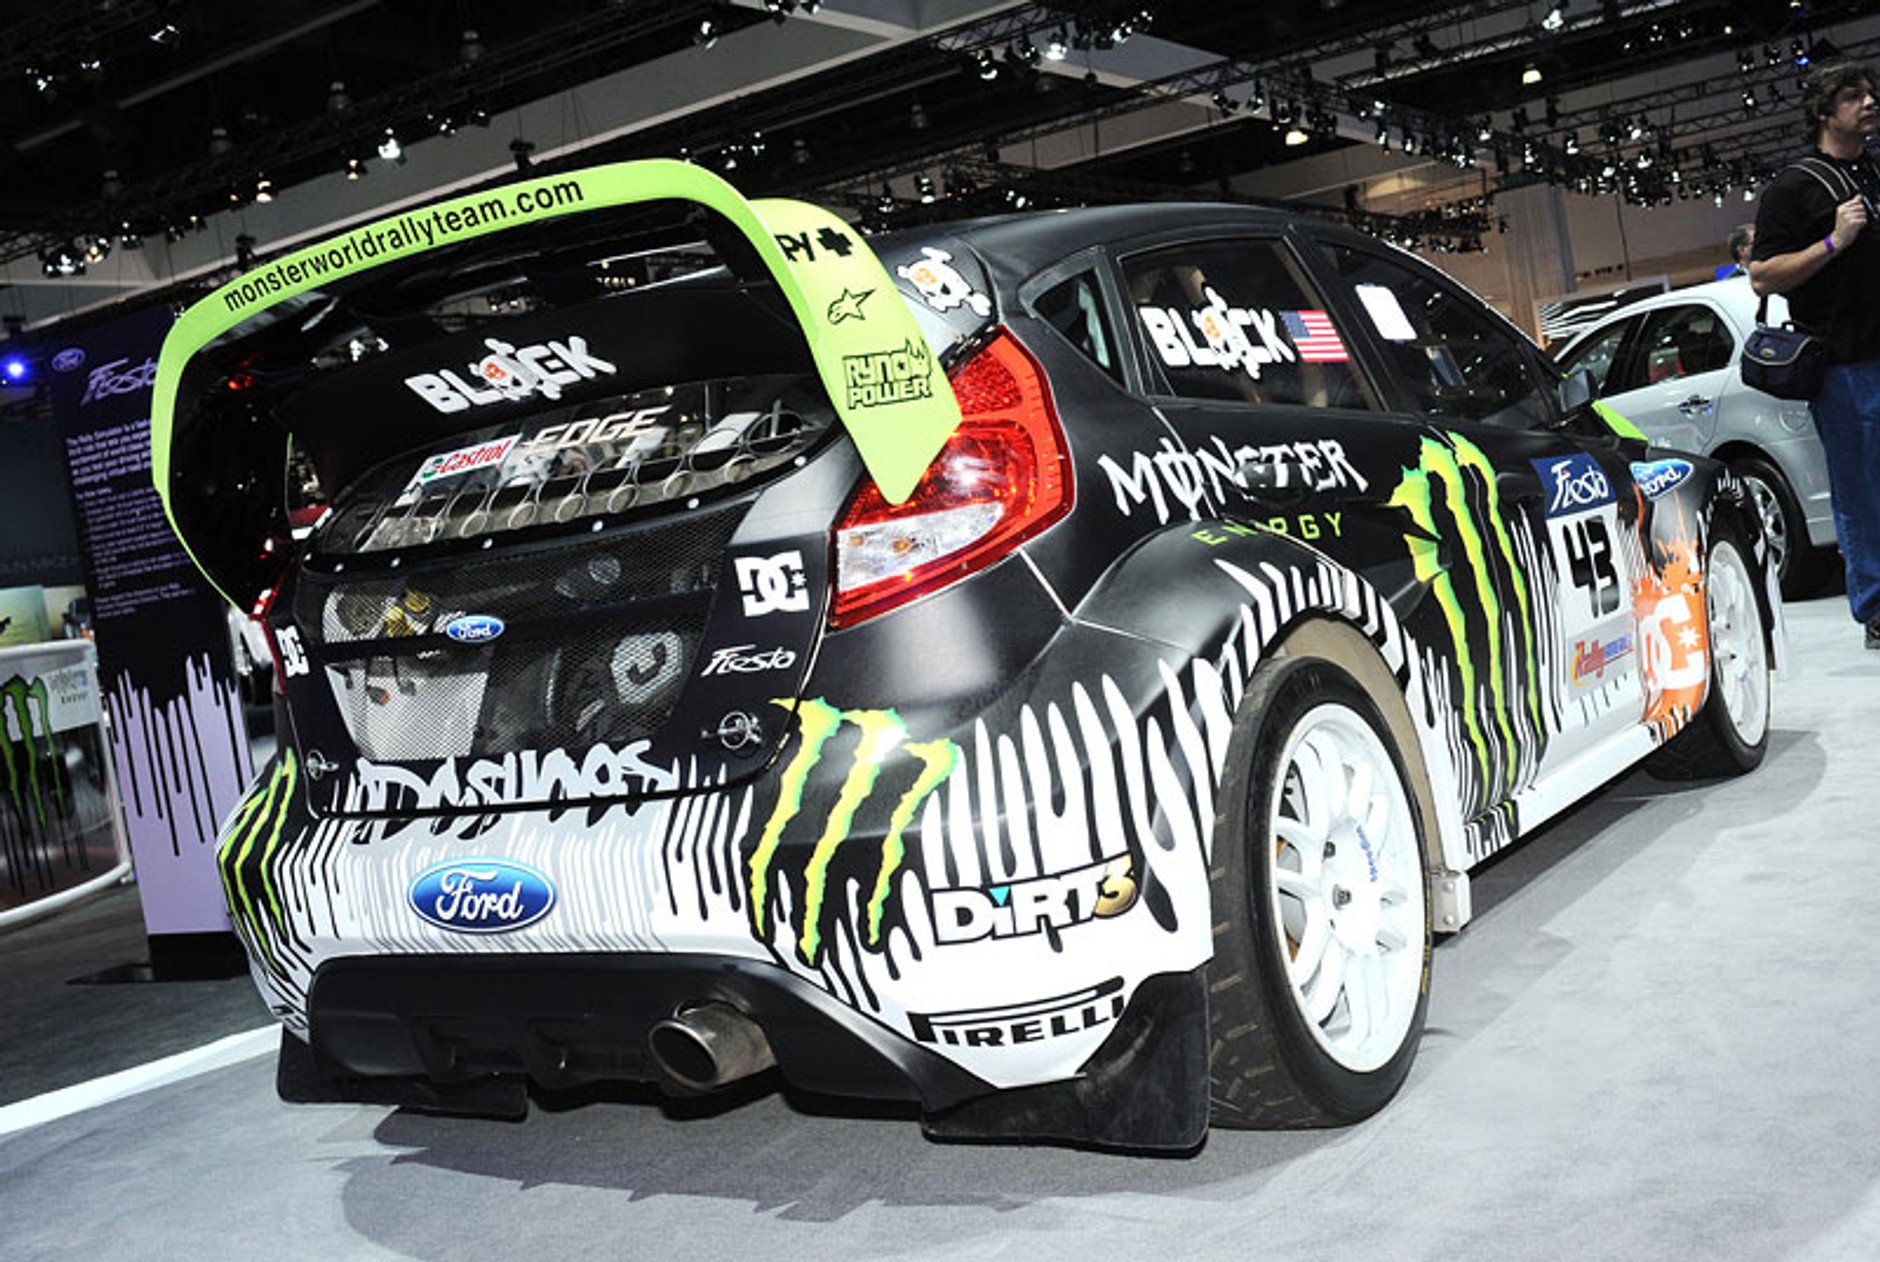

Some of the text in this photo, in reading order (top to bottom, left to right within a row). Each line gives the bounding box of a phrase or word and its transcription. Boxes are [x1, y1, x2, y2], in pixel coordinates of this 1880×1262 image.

[223, 179, 585, 312] monsterworldrallyteam.com
[522, 404, 671, 449] EDGE
[847, 378, 933, 410] POWER
[1098, 433, 1369, 525] MONSTER
[734, 549, 810, 617] DC
[1562, 514, 1620, 620] 43
[700, 644, 796, 678] Fiesta
[434, 868, 524, 921] Ford
[906, 975, 1126, 1048] PIRELLI
